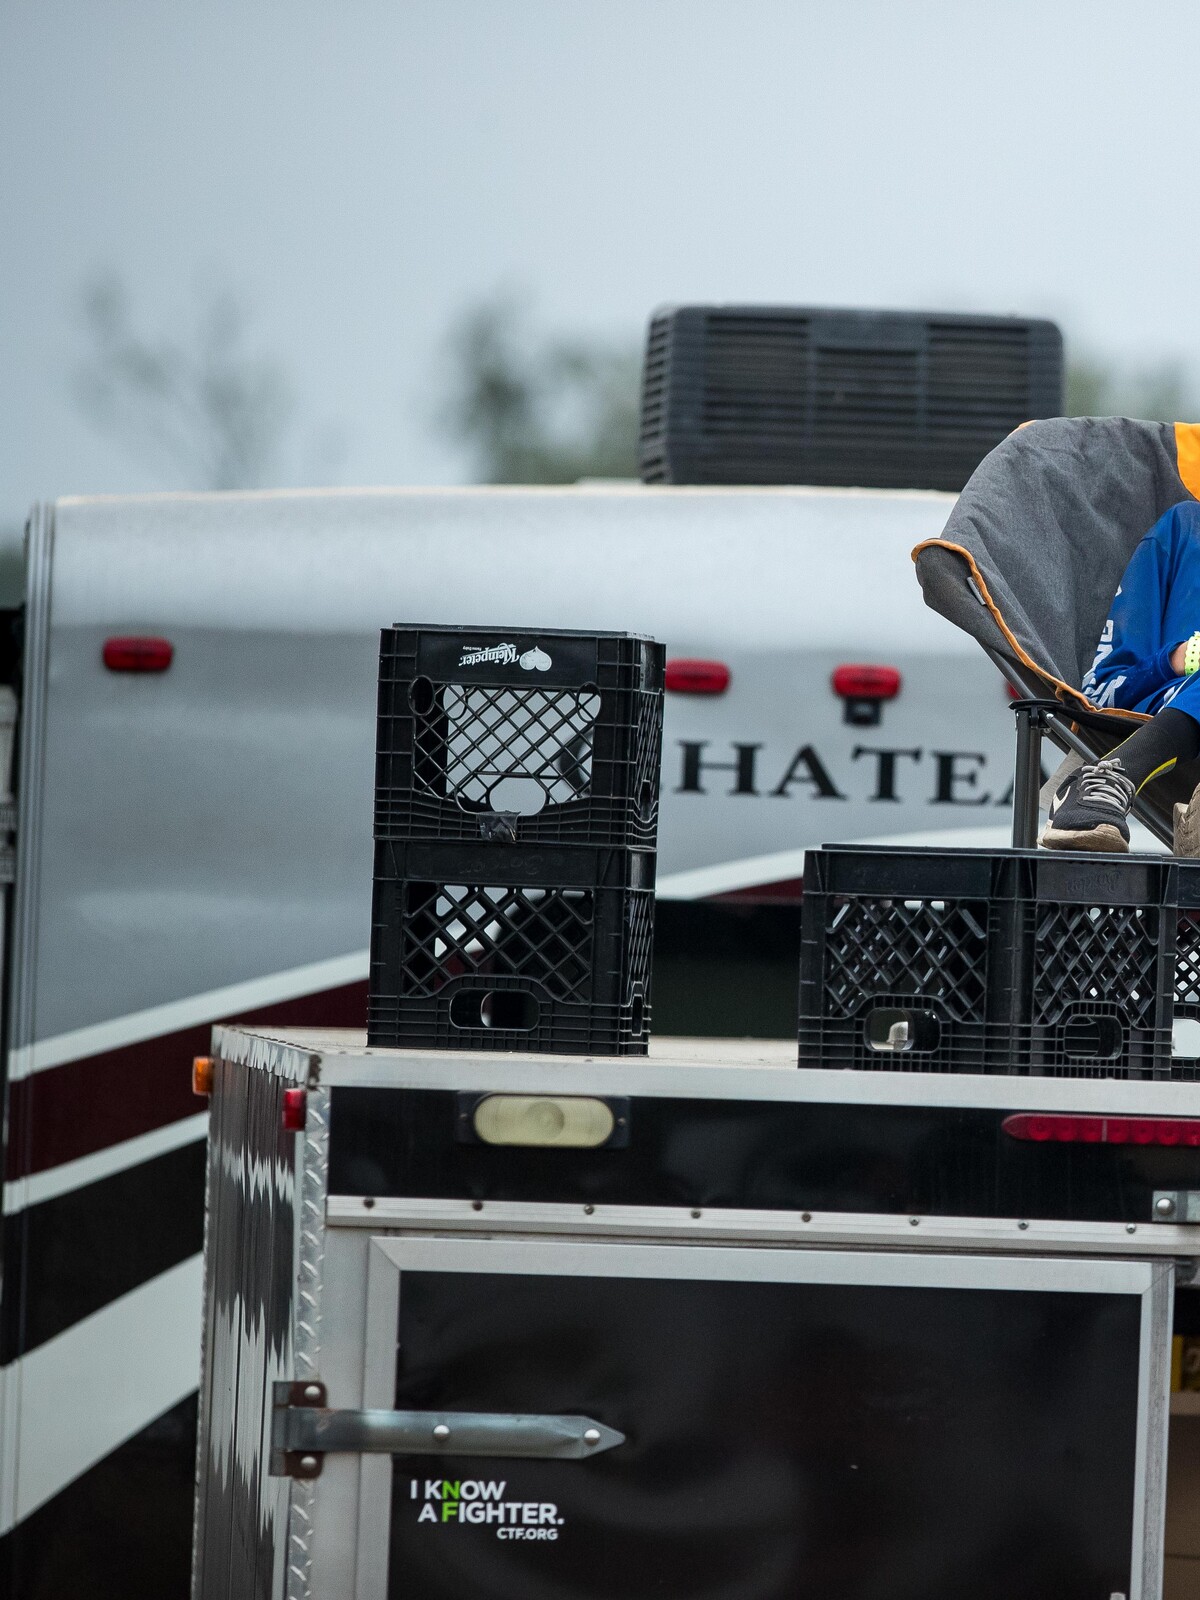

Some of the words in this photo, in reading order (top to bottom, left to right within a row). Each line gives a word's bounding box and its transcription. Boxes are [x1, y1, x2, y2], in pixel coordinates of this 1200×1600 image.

[410, 1479, 418, 1500] I
[424, 1479, 507, 1500] KNOW
[417, 1502, 438, 1523] A
[441, 1502, 565, 1525] FIGHTER.
[496, 1527, 559, 1541] CTF.ORG
